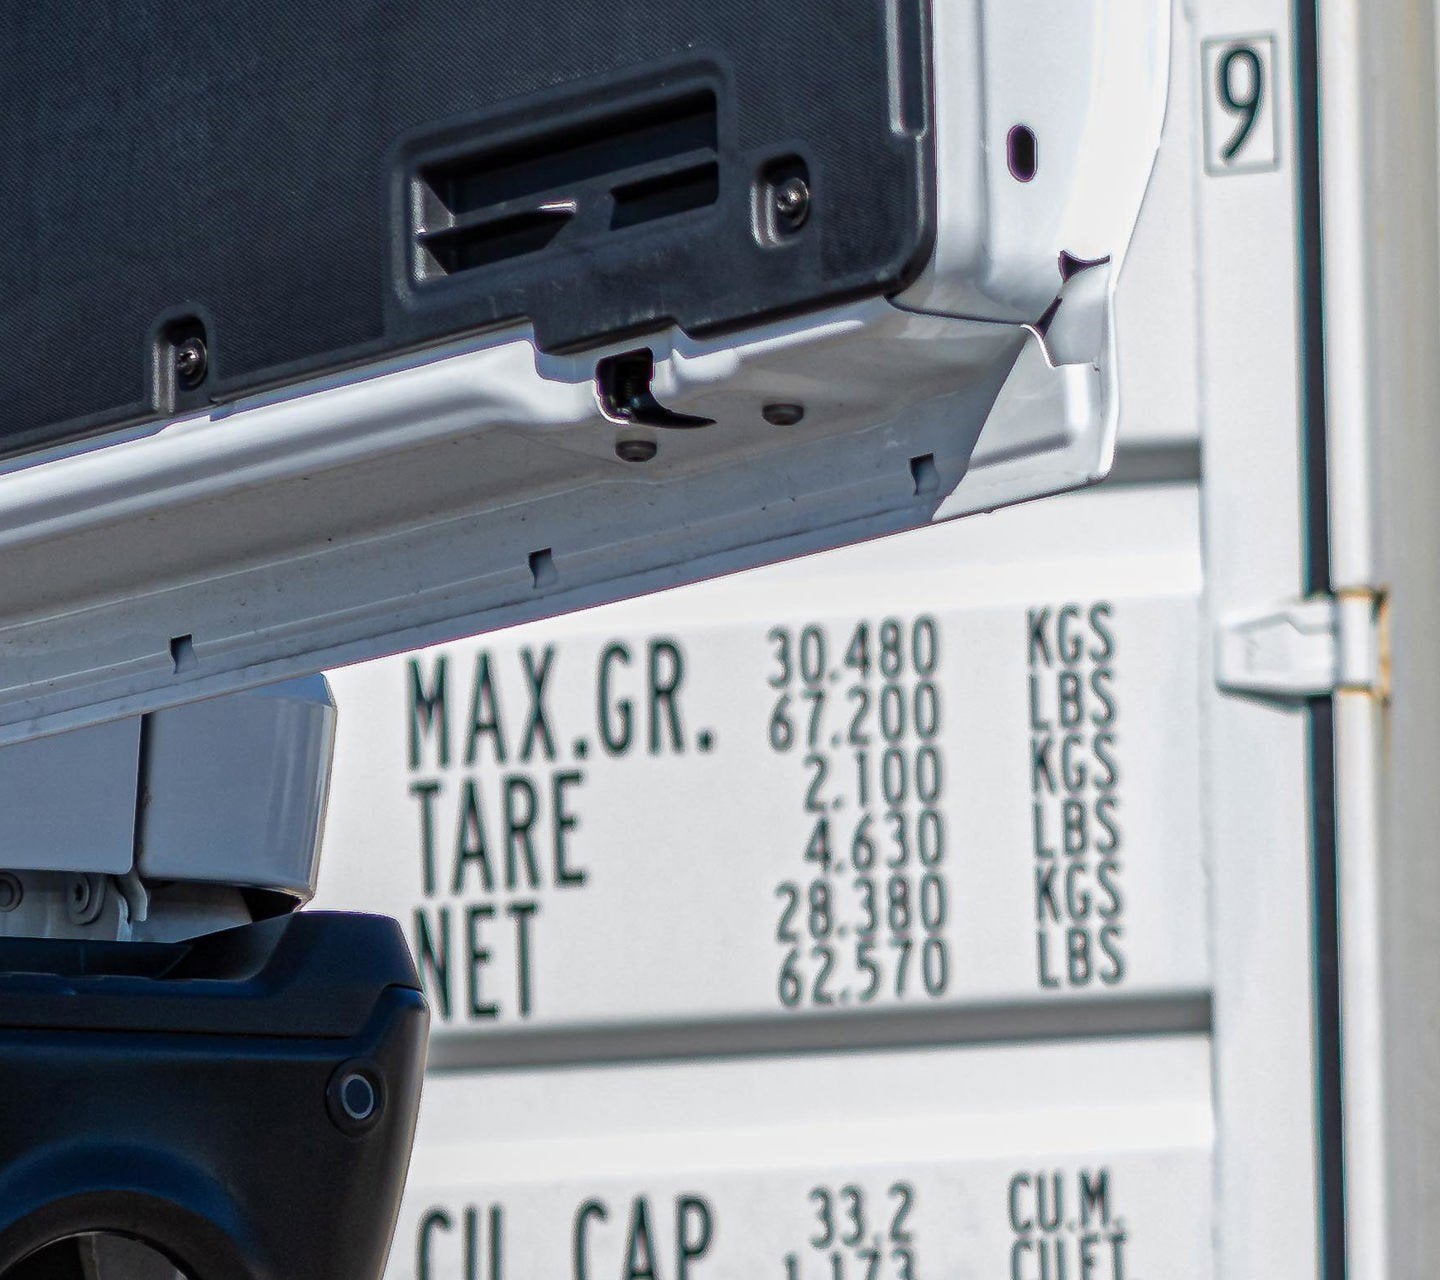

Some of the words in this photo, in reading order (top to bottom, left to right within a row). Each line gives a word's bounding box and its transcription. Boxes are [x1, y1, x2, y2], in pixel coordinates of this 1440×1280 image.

[1216, 42, 1265, 162] 9
[406, 637, 714, 771] MAX.GR.
[768, 617, 938, 688] 30.480
[1027, 603, 1114, 667] KGS
[768, 677, 940, 752] 67.200
[1028, 665, 1116, 732] LBS
[409, 770, 587, 898] TARE
[804, 743, 944, 813] 2.100
[1030, 730, 1118, 795] KGS
[804, 810, 945, 874] 4.630
[1033, 794, 1120, 859] LBS
[415, 901, 539, 1022] NET
[775, 871, 948, 943] 28.380
[1035, 858, 1123, 922] KGS
[777, 937, 948, 1009] 62.570
[1036, 923, 1125, 989] LBS
[809, 1181, 916, 1248] 33.2
